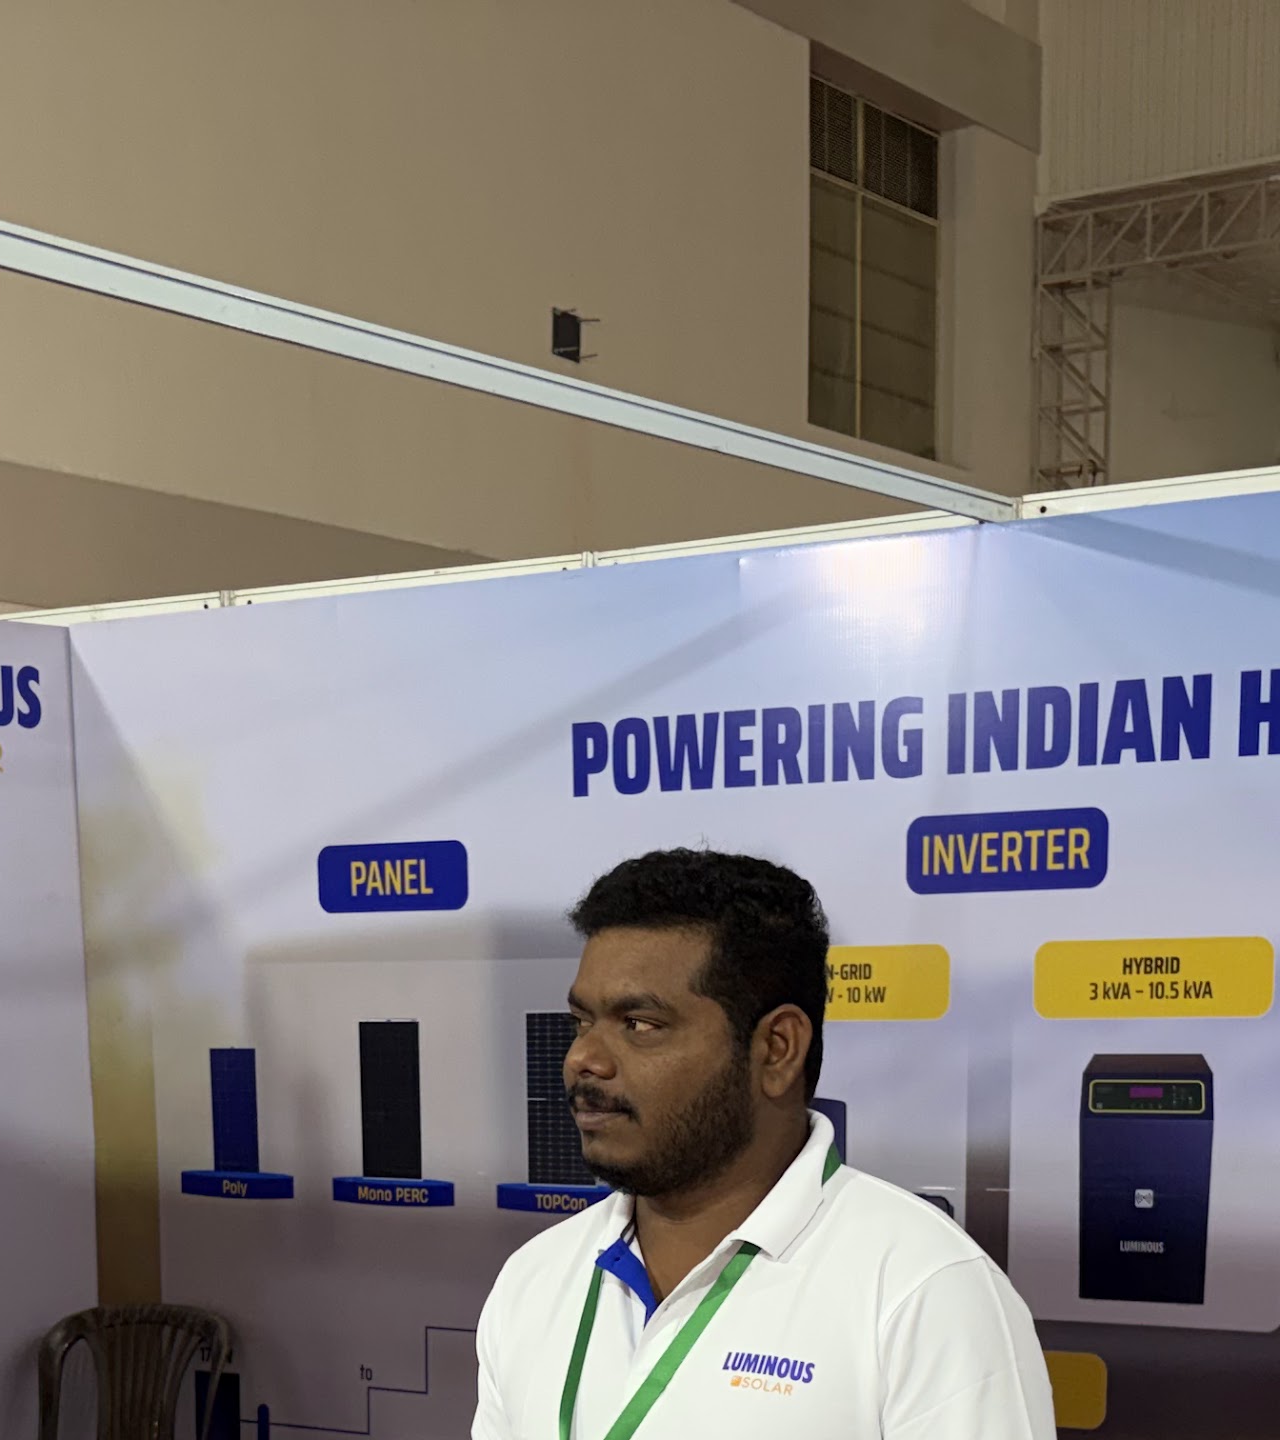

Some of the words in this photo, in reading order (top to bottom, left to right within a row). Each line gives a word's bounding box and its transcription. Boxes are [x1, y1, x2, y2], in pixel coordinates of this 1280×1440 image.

[571, 694, 924, 798] POWERING
[947, 673, 1214, 776] INDIAN
[920, 827, 1091, 877] INVERTER
[350, 858, 434, 896] PANEL
[826, 963, 872, 981] N-GRID
[1122, 956, 1181, 976] HYBRID
[847, 987, 861, 1003] 10
[864, 985, 887, 1003] kW
[1089, 982, 1098, 1000] 3
[1103, 981, 1132, 1000] kVA
[1149, 981, 1179, 1000] 10.5
[1183, 980, 1214, 999] kVA
[223, 1180, 248, 1197] Poly
[358, 1187, 393, 1202] Mono
[396, 1187, 429, 1203] PERC
[535, 1193, 588, 1211] TOPCon
[1120, 1240, 1165, 1253] LUMINOUS
[360, 1364, 373, 1381] to
[722, 1352, 816, 1384] LUMINOUS
[741, 1376, 793, 1396] SOLAR
